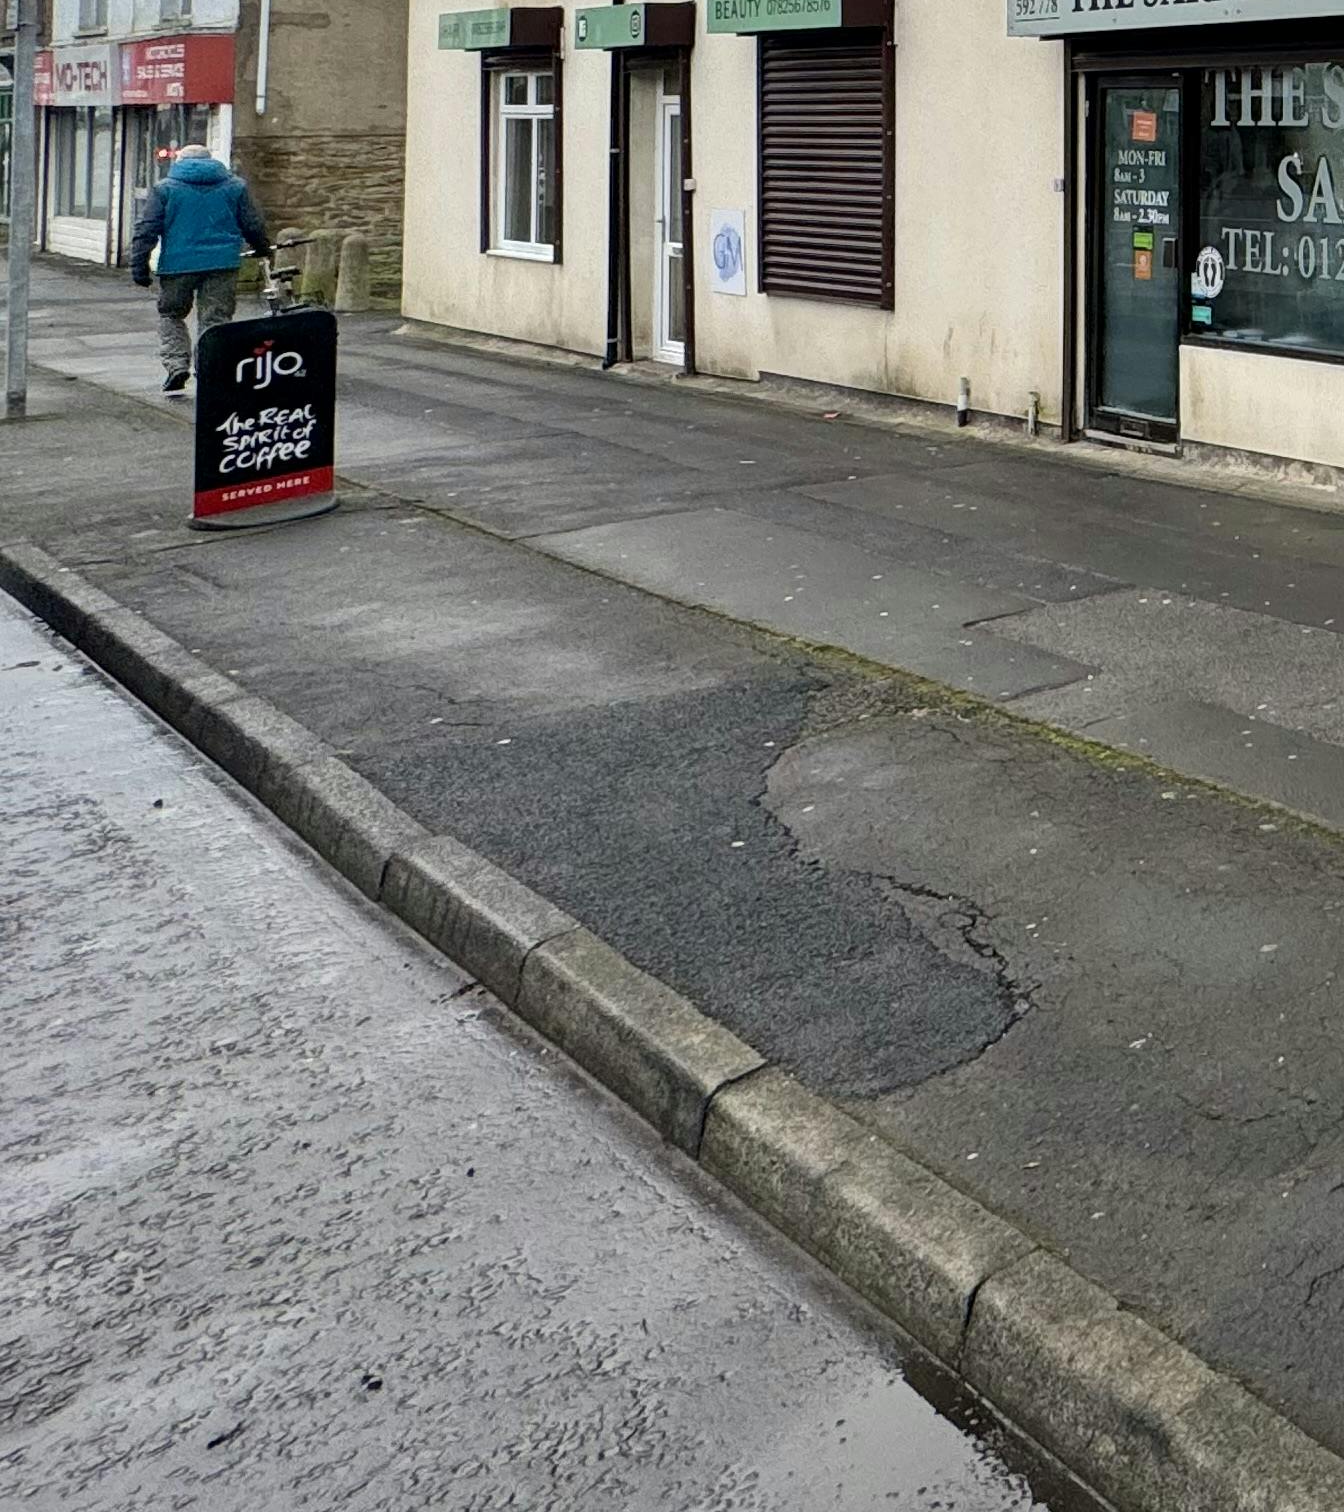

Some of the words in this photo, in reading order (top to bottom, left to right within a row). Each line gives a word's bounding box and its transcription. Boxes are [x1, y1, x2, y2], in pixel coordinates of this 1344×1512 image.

[1205, 65, 1309, 128] THE
[1117, 150, 1167, 167] MON-FRI
[1139, 169, 1146, 184] 3
[1114, 189, 1170, 207] SATURDAY
[1221, 227, 1290, 277] TEL:
[236, 340, 303, 390] rijo
[216, 411, 256, 436] The
[292, 419, 317, 440] of
[222, 483, 273, 502] SERVED
[276, 475, 311, 491] HERE
